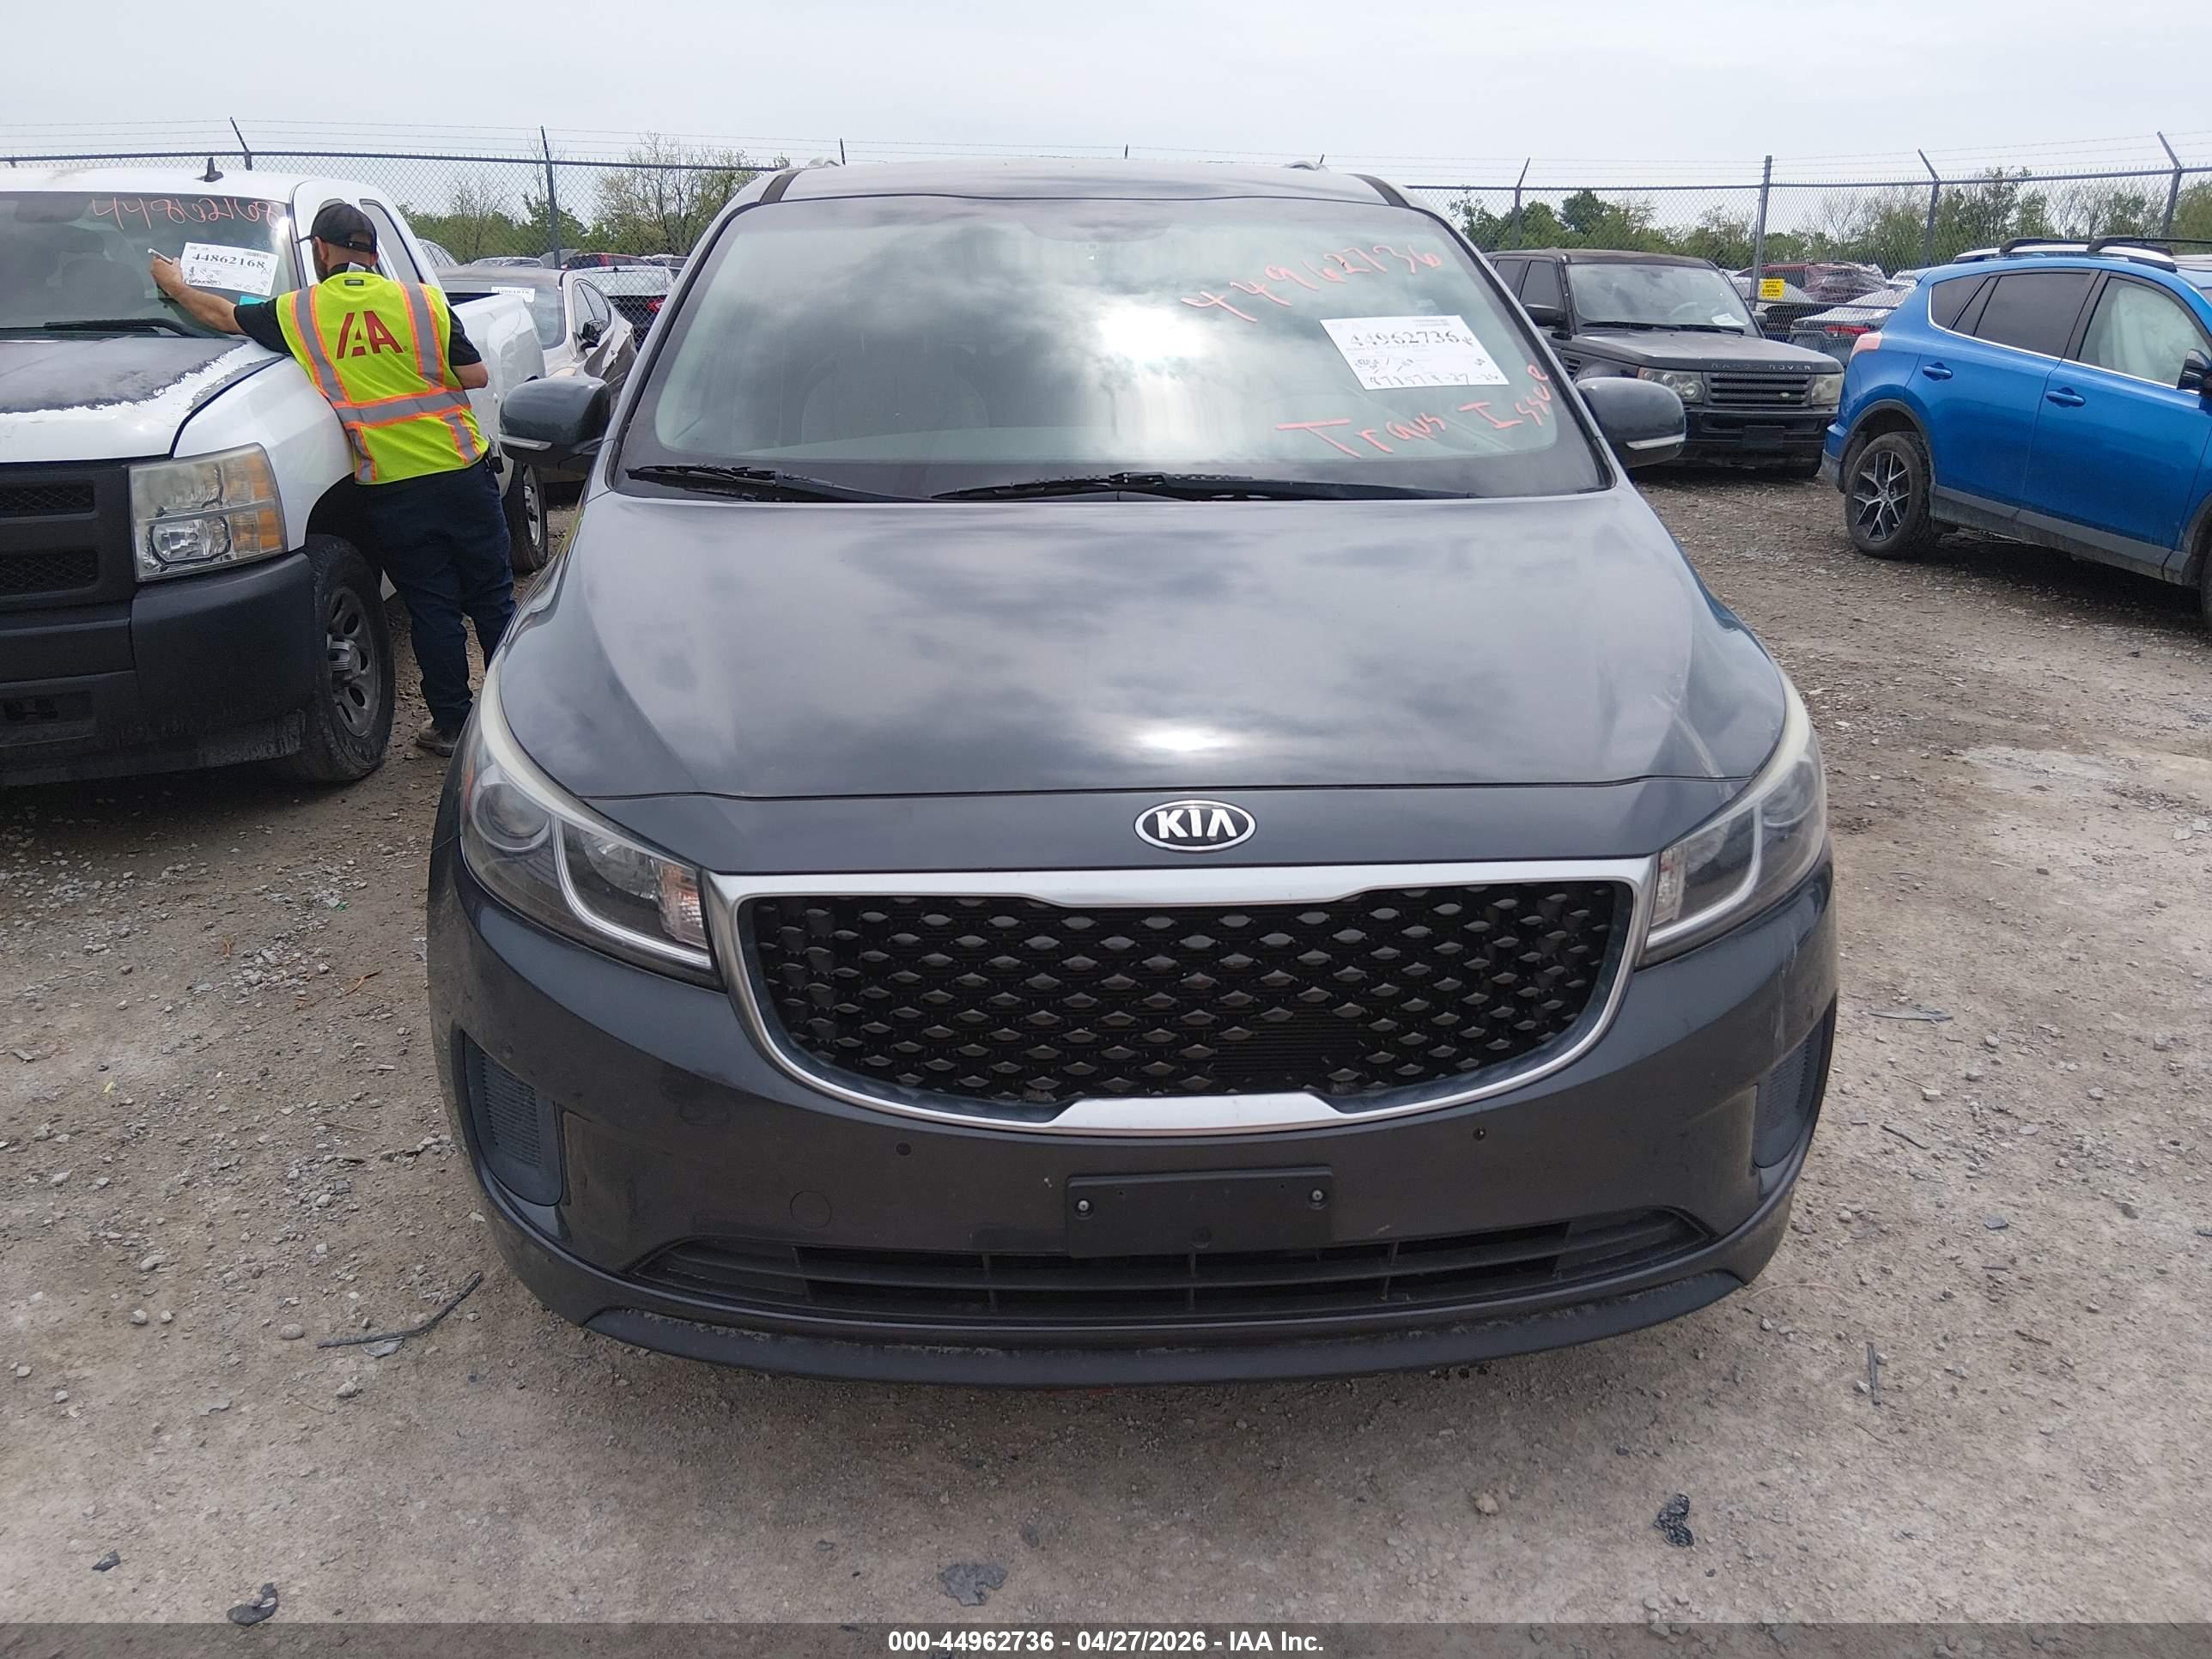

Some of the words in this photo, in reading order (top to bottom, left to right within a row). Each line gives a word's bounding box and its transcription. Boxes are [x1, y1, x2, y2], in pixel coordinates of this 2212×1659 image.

[92, 197, 279, 230] 44862168
[192, 253, 265, 268] 44862168
[1182, 245, 1442, 323] 44962736
[1349, 330, 1460, 347] 44962736
[1277, 412, 1447, 459] Trans
[1155, 809, 1237, 839] KIA
